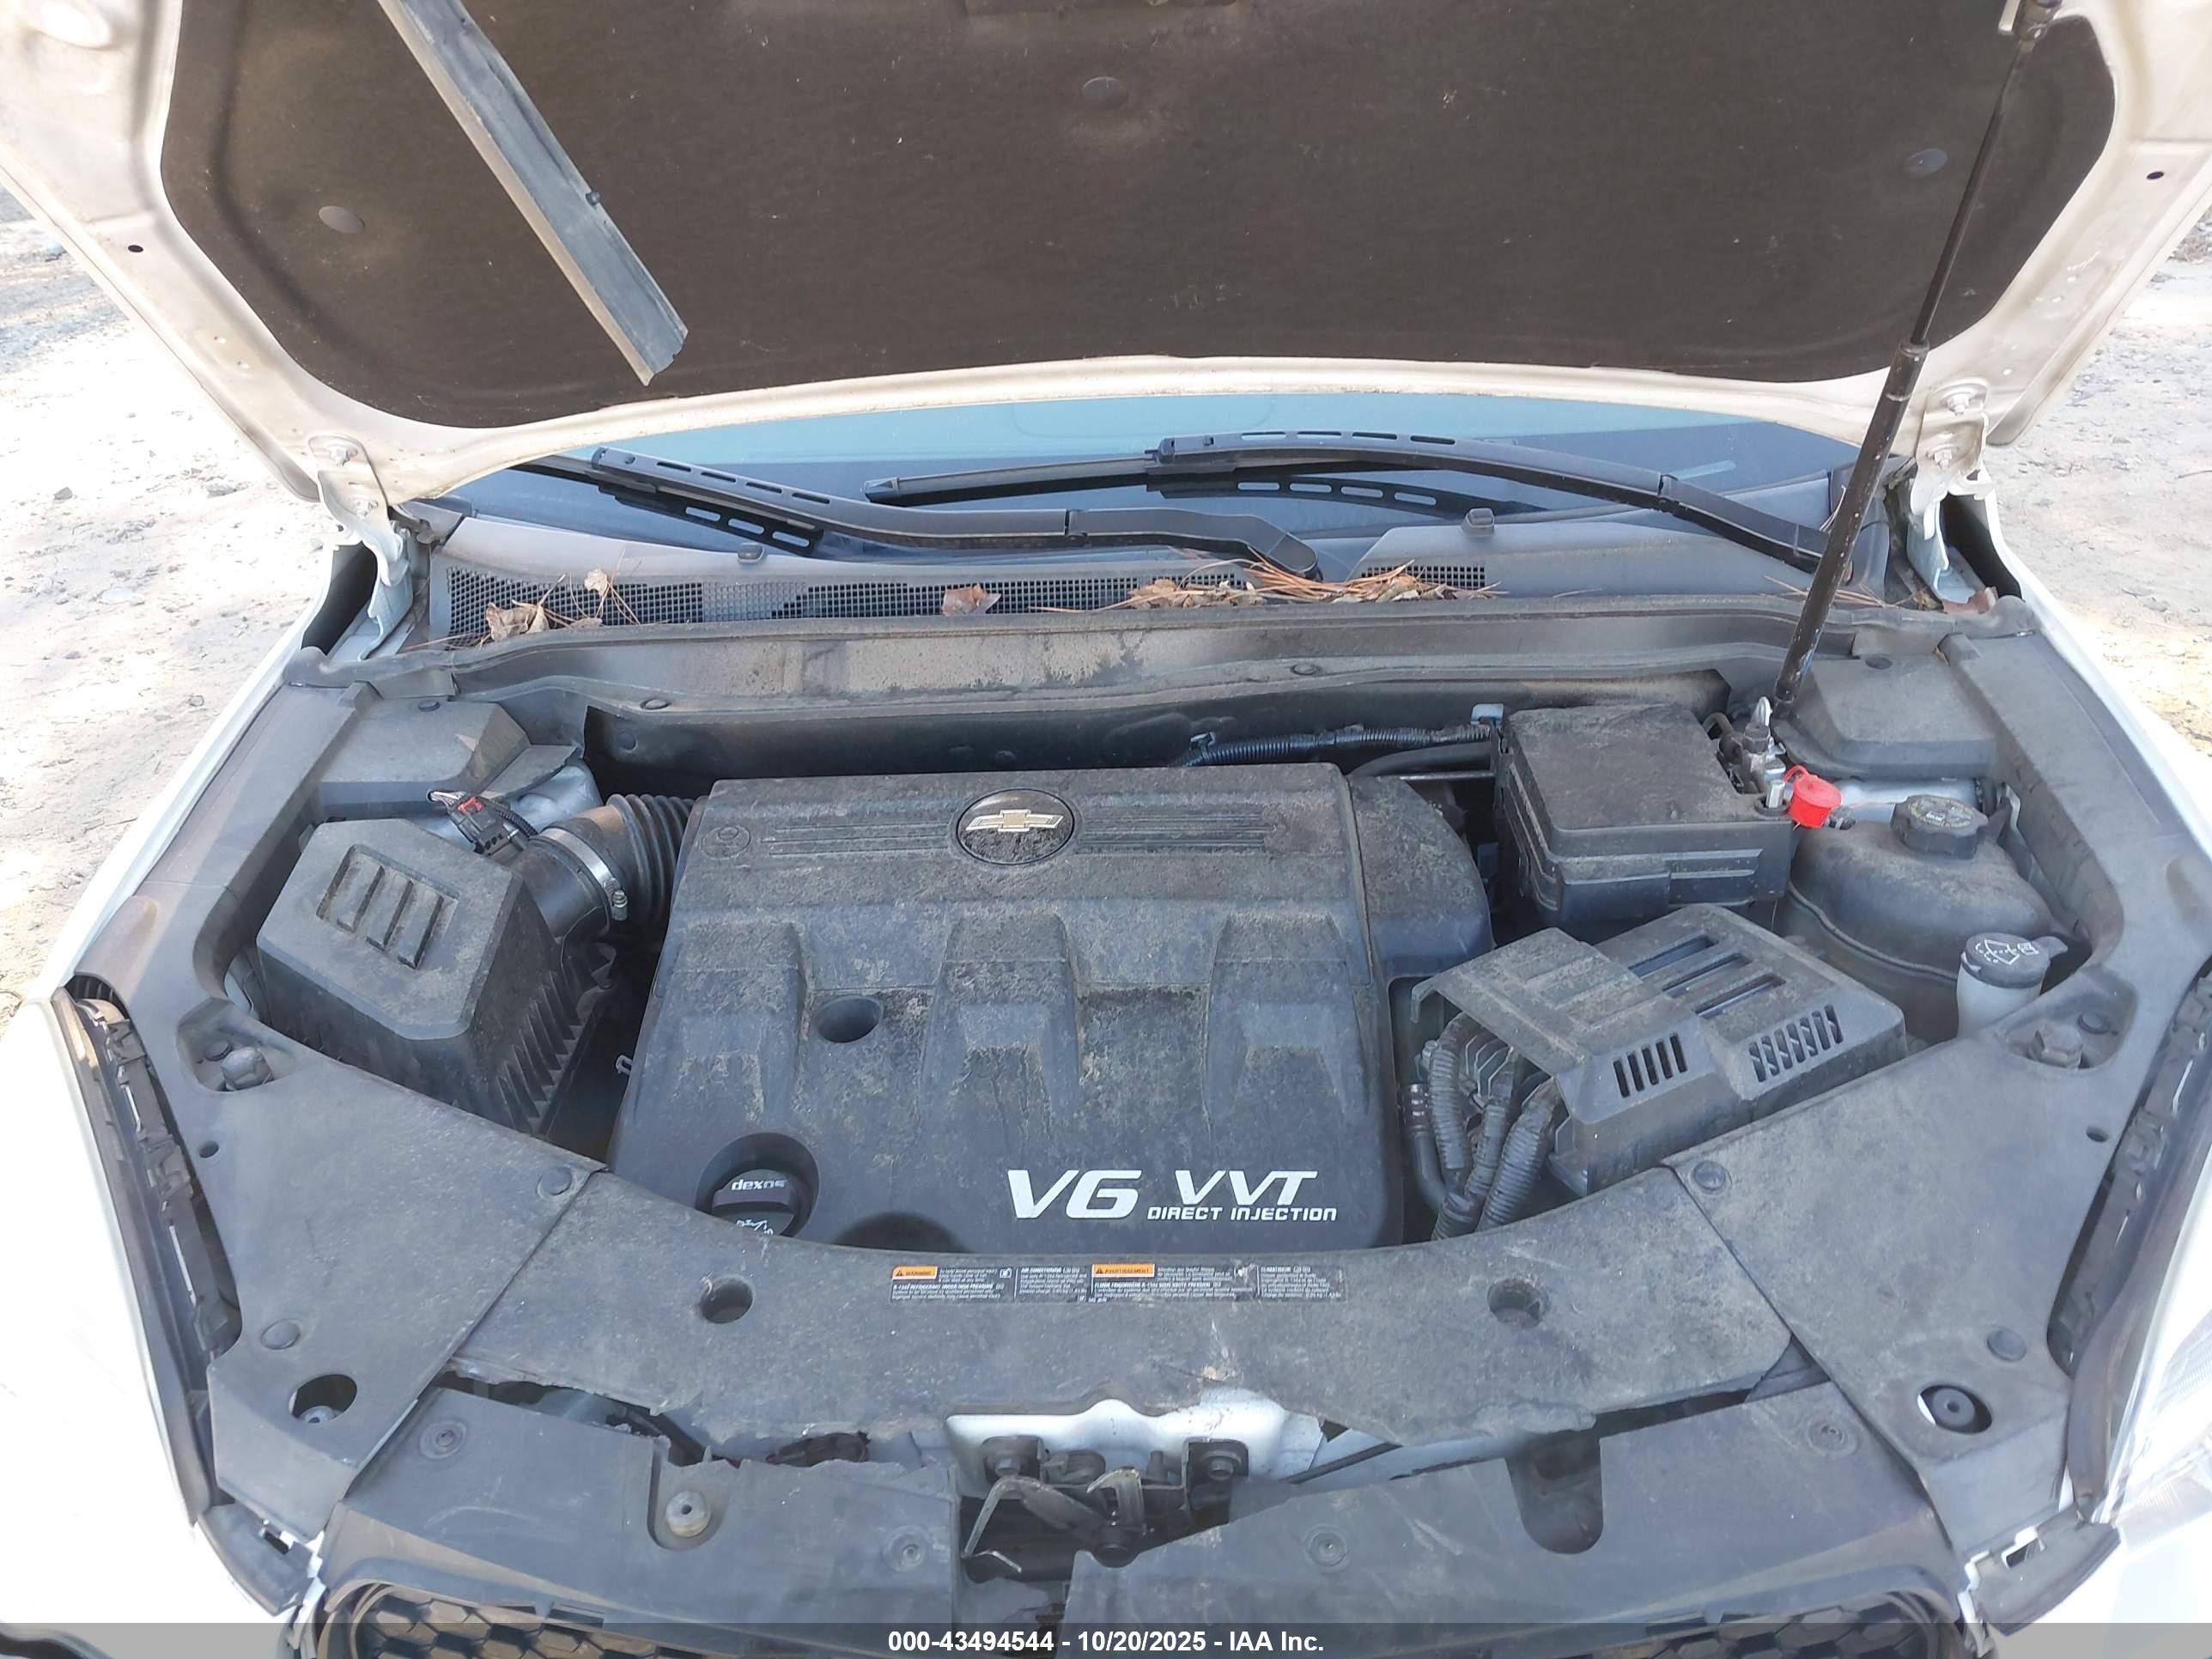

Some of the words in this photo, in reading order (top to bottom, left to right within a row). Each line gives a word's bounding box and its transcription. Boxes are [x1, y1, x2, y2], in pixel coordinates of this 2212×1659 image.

[731, 1179, 787, 1191] dexos
[1007, 1170, 1143, 1220] V6
[1175, 1170, 1319, 1206] VVT
[1147, 1206, 1223, 1221] DIRECT
[1230, 1207, 1338, 1222] INJECTION
